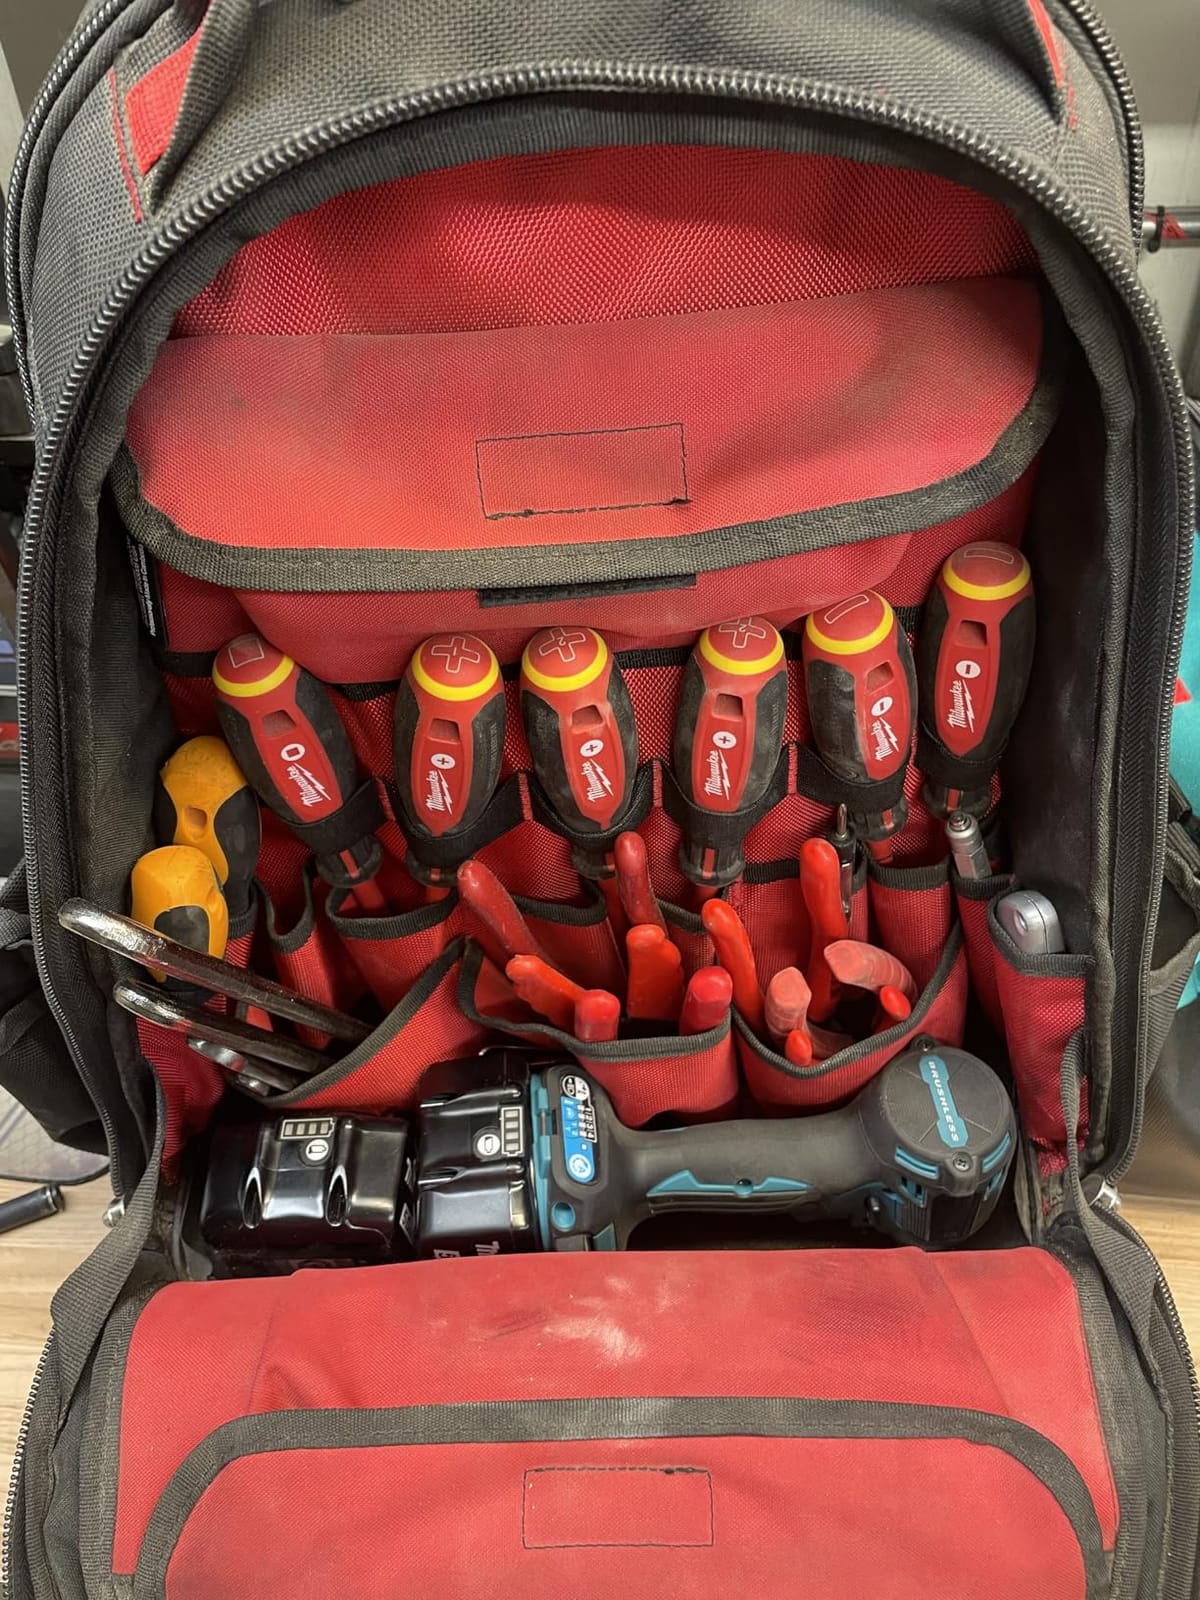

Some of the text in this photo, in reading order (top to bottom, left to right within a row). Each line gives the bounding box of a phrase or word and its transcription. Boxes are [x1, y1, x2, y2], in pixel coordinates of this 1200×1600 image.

[947, 679, 968, 728] Milwaukee
[871, 719, 893, 761] Milwaukee
[286, 764, 323, 807] Milwaukee
[425, 769, 447, 812] Milwaukee
[581, 761, 607, 803] Milwaukee
[704, 750, 723, 796] Milwaukee
[928, 1061, 959, 1142] BRUSHLESS
